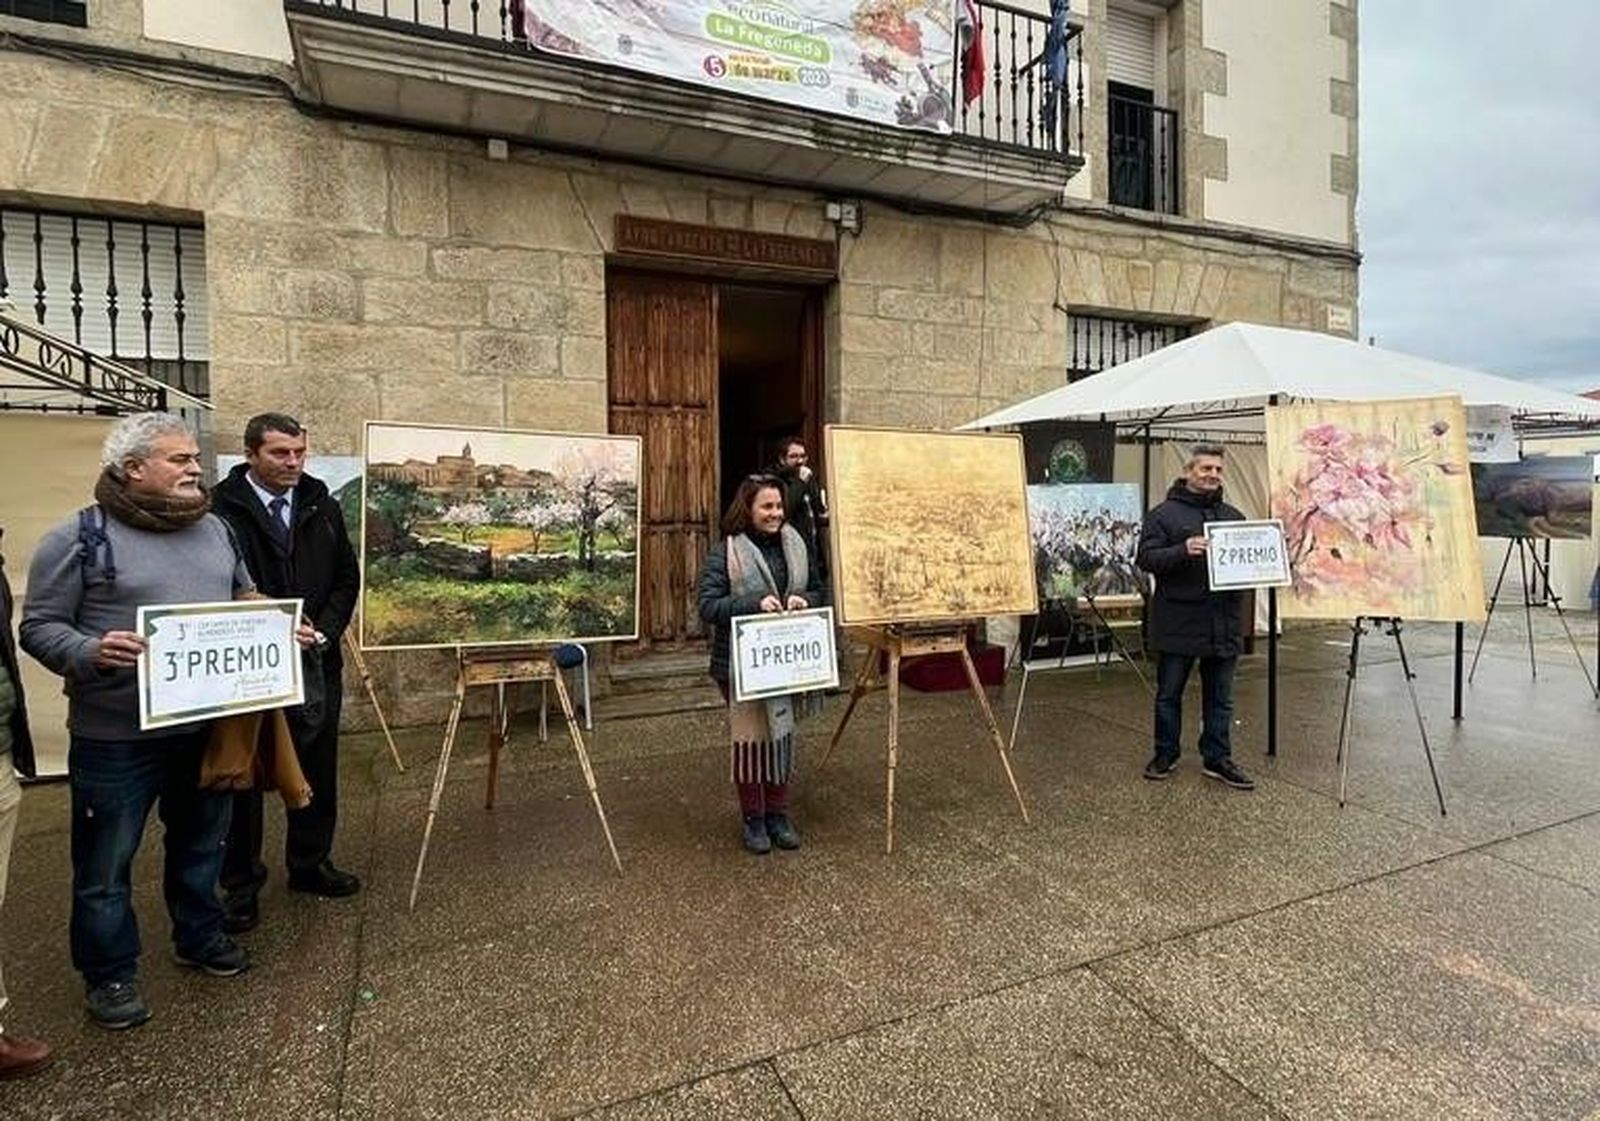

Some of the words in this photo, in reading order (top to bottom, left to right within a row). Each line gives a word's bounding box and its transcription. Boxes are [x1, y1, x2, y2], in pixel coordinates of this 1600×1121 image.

[716, 19, 734, 36] La
[739, 24, 823, 59] Fregeneda
[1229, 546, 1278, 564] PREMIO
[188, 643, 280, 679] PREMIO
[762, 641, 822, 666] PREMIO
